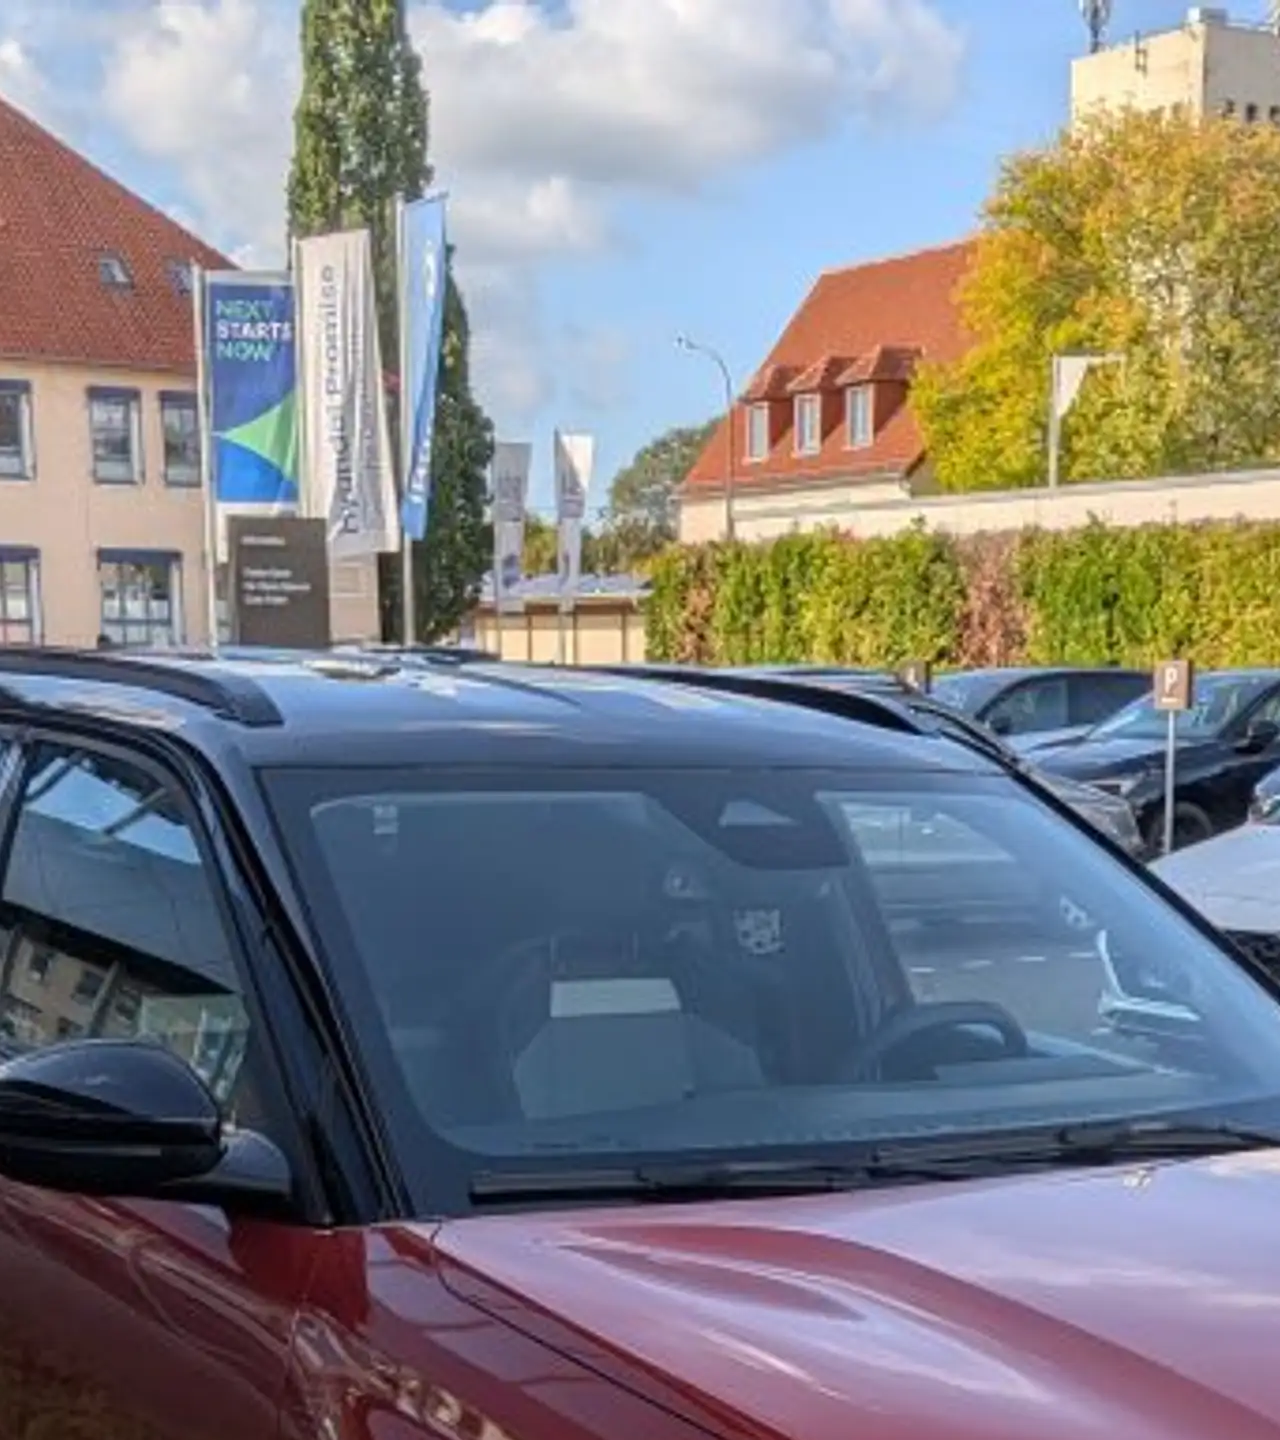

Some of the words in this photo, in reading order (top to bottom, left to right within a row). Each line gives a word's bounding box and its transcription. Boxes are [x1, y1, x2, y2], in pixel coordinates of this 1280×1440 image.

[320, 265, 343, 395] Promise
[216, 340, 275, 362] NOW
[1164, 667, 1178, 694] P
